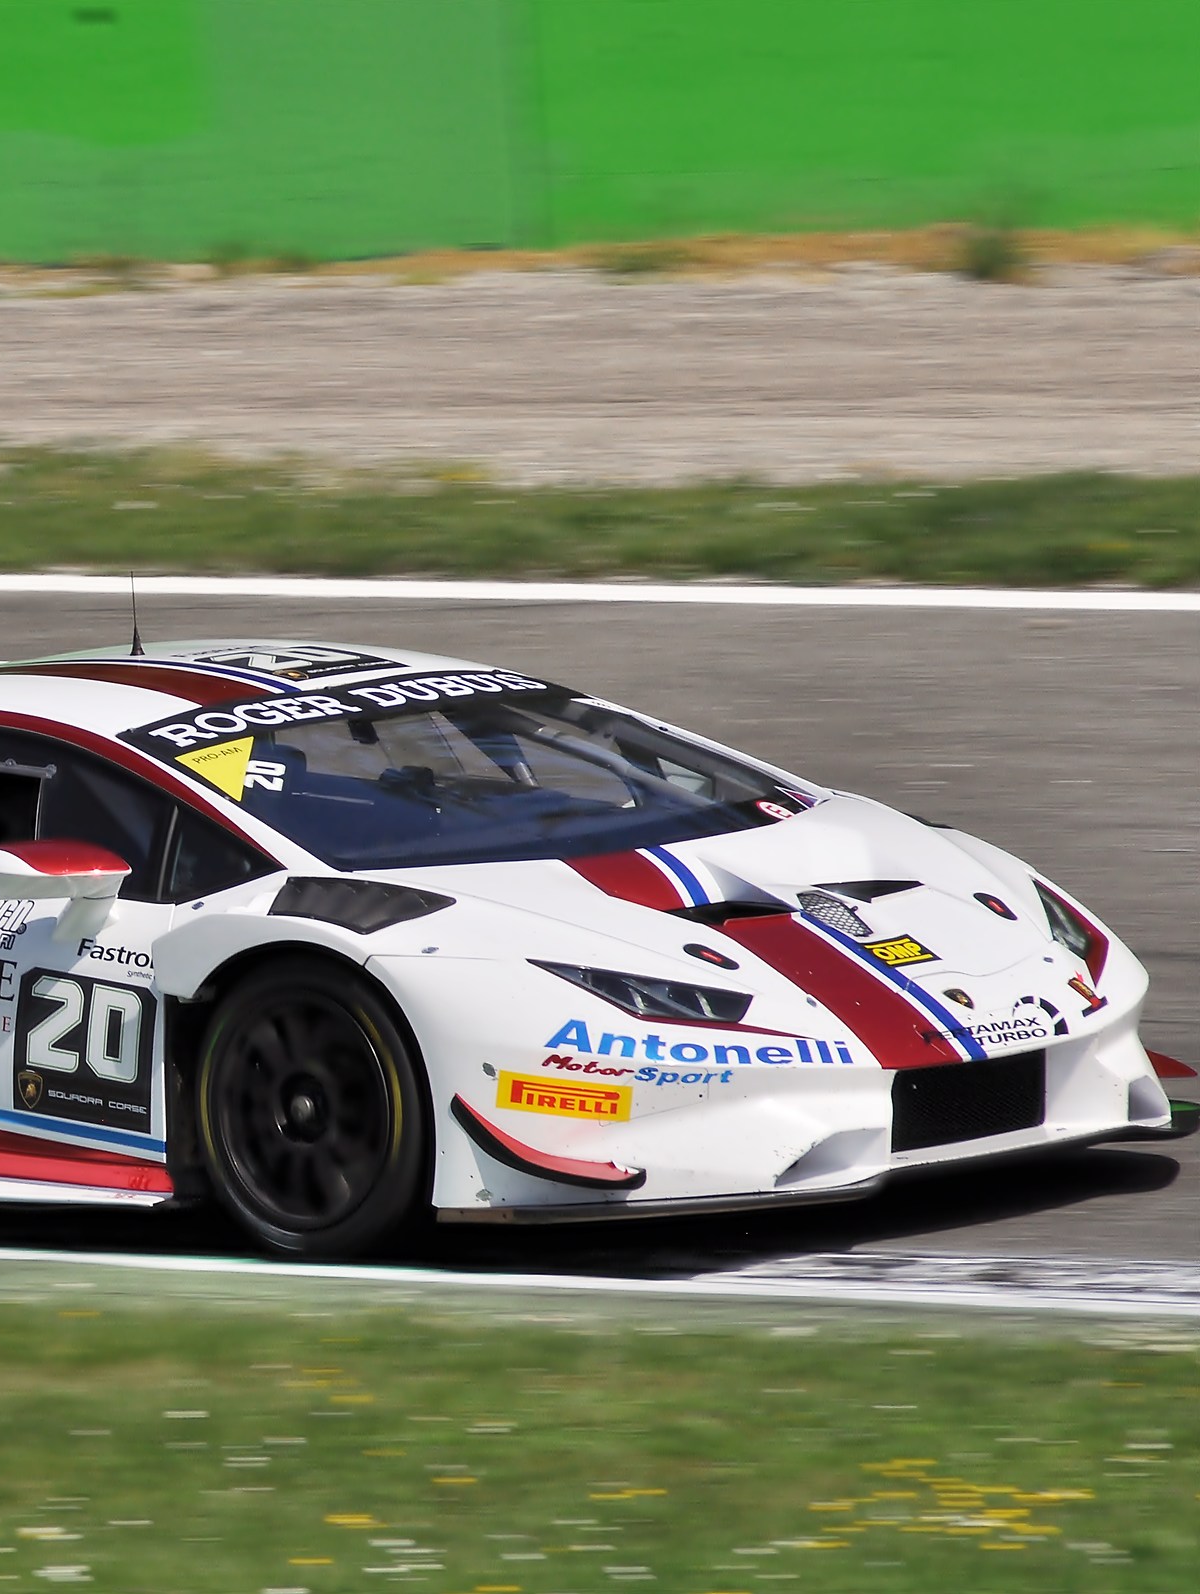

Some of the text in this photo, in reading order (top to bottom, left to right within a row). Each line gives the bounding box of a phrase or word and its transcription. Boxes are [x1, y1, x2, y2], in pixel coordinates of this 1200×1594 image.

[149, 672, 547, 748] ROGER DUBUIS
[192, 747, 243, 764] PRO-AM
[870, 941, 923, 962] OMP
[25, 974, 146, 1084] 20
[544, 1019, 855, 1065] Antonelli
[975, 1028, 1047, 1046] TURBO
[48, 1089, 147, 1114] SQUADRA CORSE
[510, 1080, 620, 1115] PIRELLI
